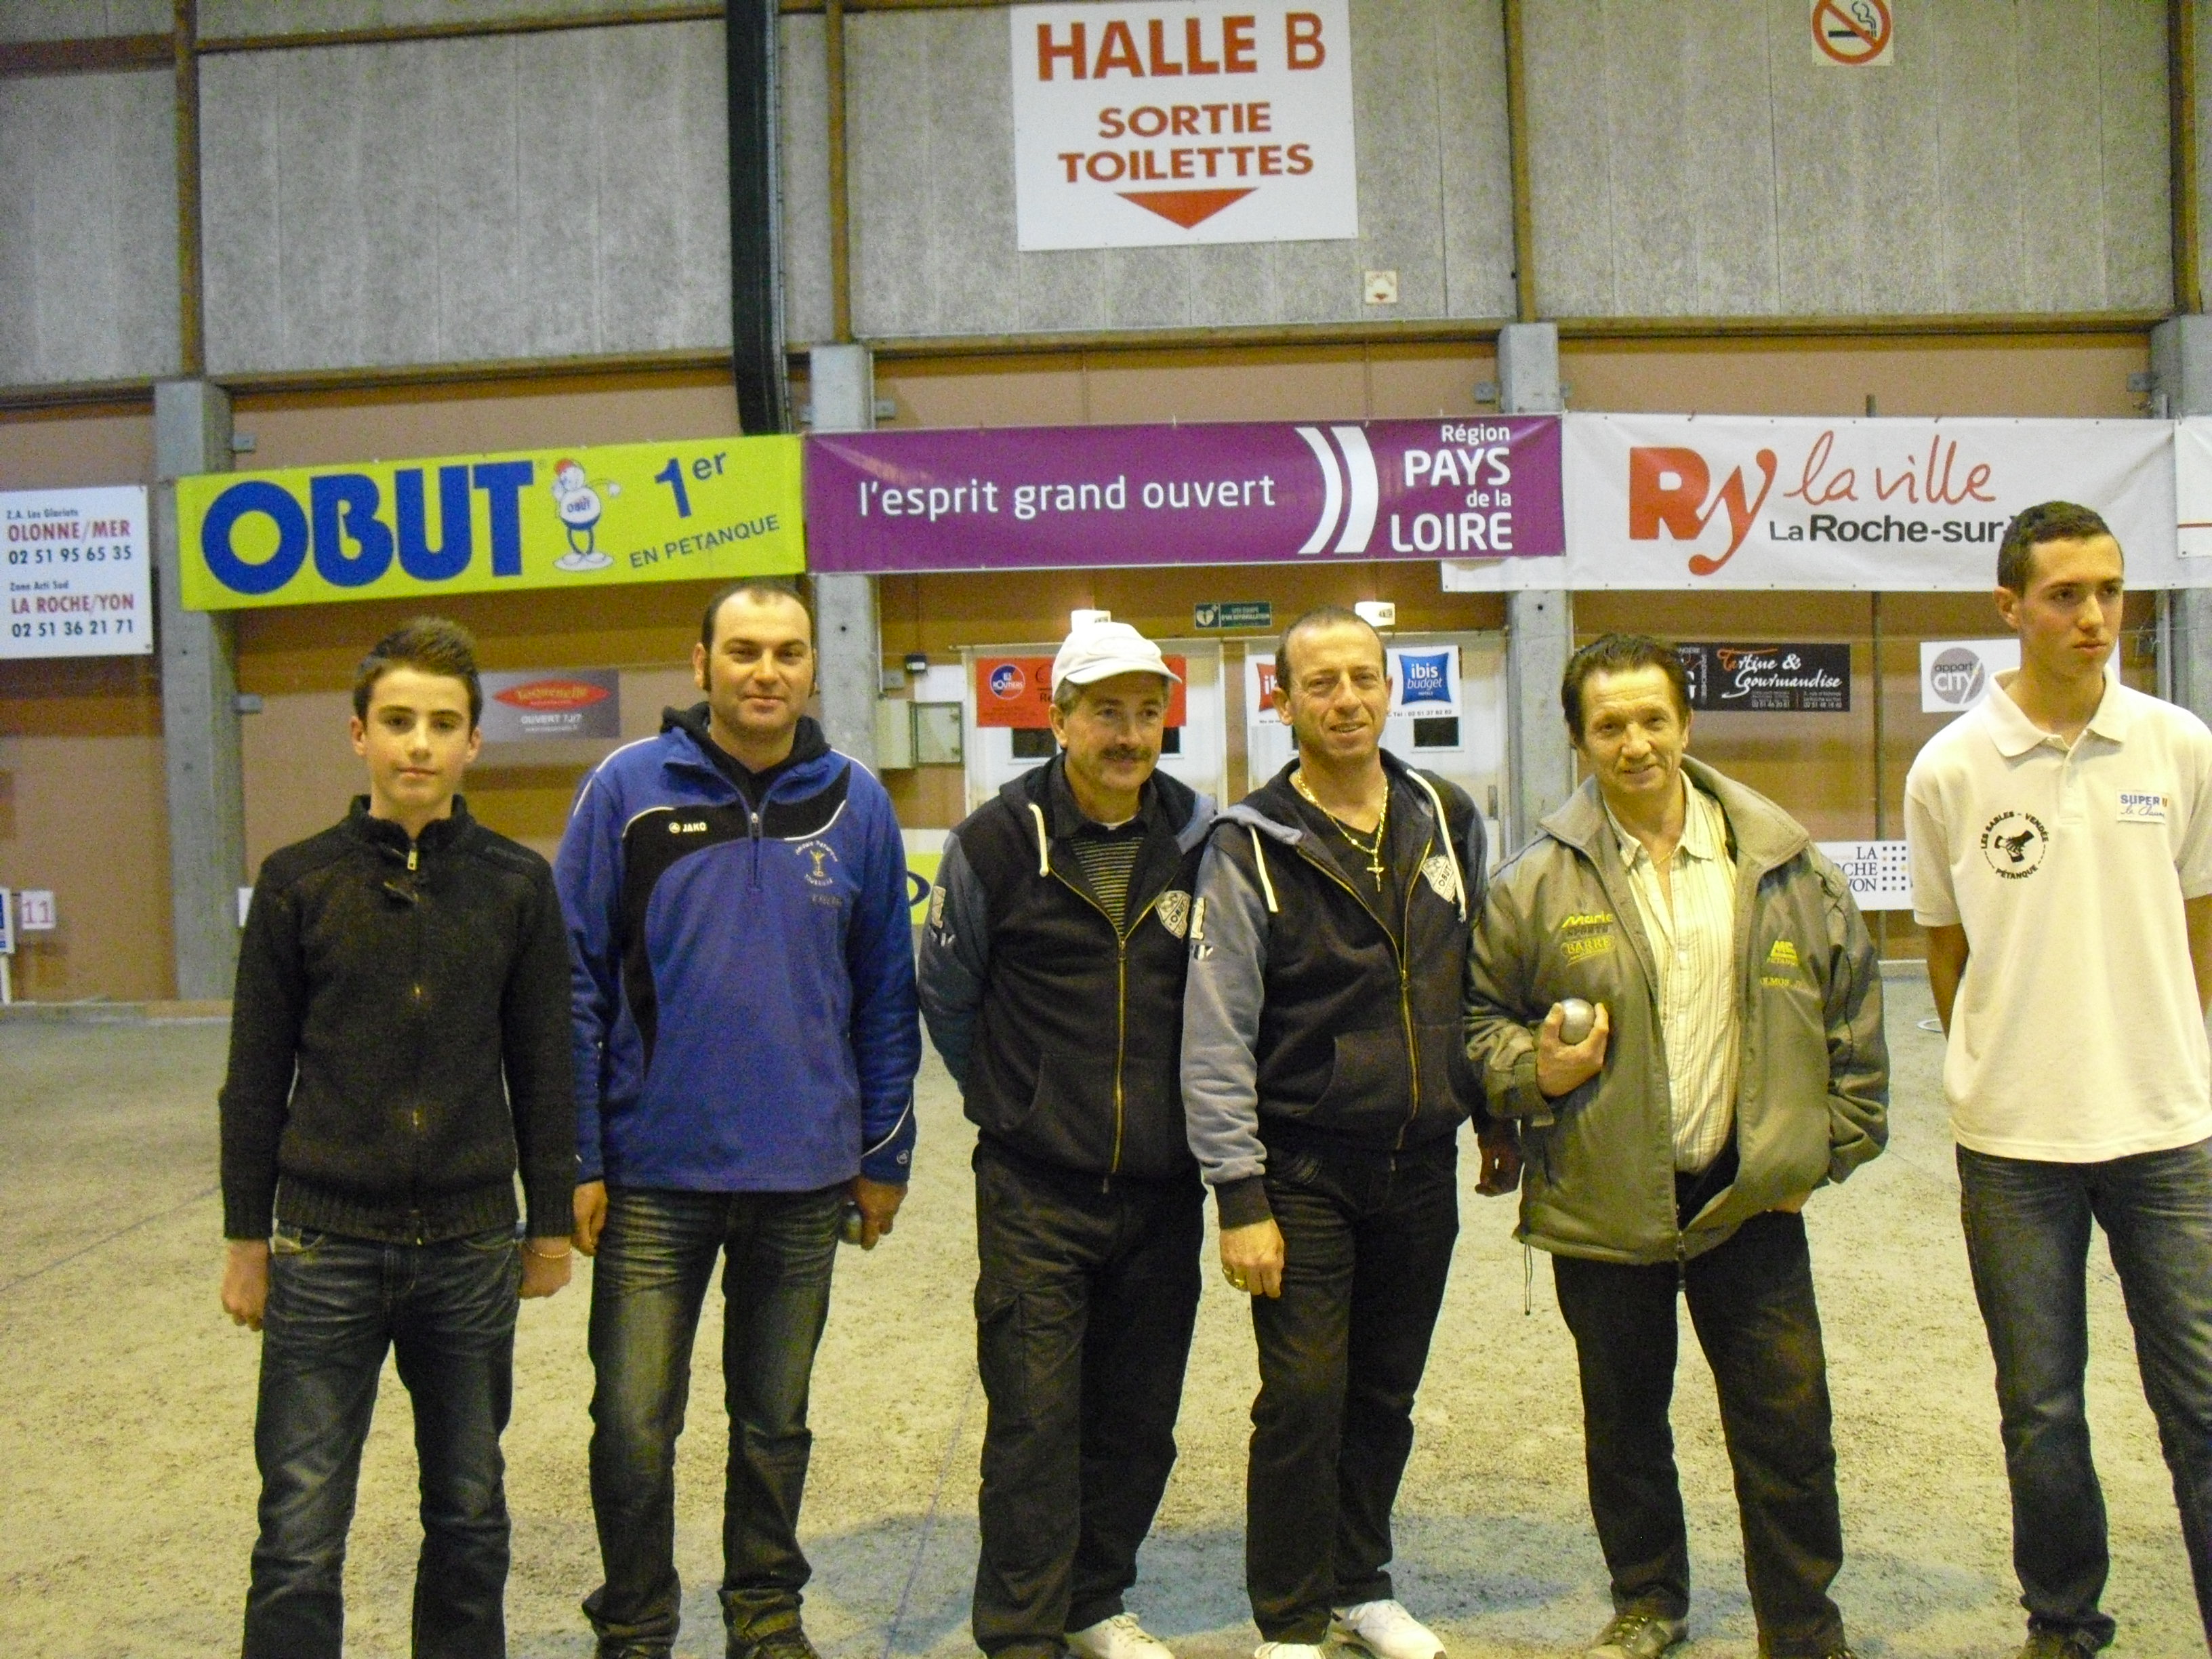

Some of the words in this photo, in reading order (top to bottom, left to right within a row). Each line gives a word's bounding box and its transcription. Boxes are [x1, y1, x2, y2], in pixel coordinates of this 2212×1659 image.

[1036, 15, 1257, 81] HALLE
[1285, 12, 1326, 70] B
[1098, 101, 1272, 139] SORTIE
[1057, 143, 1314, 183] TOILETTES
[1441, 424, 1511, 445] Région
[1404, 447, 1511, 487] PAYS
[1783, 430, 1859, 506] la
[1875, 434, 1996, 506] ville
[654, 451, 726, 518] 1er
[860, 478, 999, 522] l'esprit
[1015, 476, 1126, 520] grand
[1143, 475, 1275, 508] ouvert
[1467, 489, 1490, 507] de
[1496, 489, 1511, 507] la
[201, 459, 533, 595] OBUT
[1391, 512, 1513, 552] LOIRE
[1769, 520, 1803, 541] La
[1809, 514, 2006, 543] Roche-sur
[630, 546, 659, 568] EN
[664, 514, 780, 558] PETANQUE
[9, 550, 28, 565] 02
[36, 549, 52, 563] 51
[61, 548, 79, 562] 95
[87, 546, 105, 561] 65
[113, 546, 131, 560] 35
[12, 598, 31, 614] LA
[12, 623, 31, 638] 02
[39, 622, 55, 636] 51
[64, 621, 83, 635] 36
[90, 620, 106, 635] 21
[116, 619, 133, 634] 71
[1411, 662, 1439, 679] ibis
[1717, 648, 1778, 671] Tartine
[1782, 653, 1802, 670] &
[1935, 661, 1973, 673] appart
[1407, 677, 1442, 691] budget
[1721, 667, 1843, 698] Gourmandise
[521, 714, 560, 724] OUVERT
[2120, 794, 2160, 805] SUPER
[682, 822, 707, 832] JAKO
[1986, 811, 2014, 832] SABLES
[2025, 813, 2049, 842] VENDÉE
[1856, 846, 1878, 860] LA
[1835, 863, 1878, 876] CHE
[24, 899, 49, 923] 11
